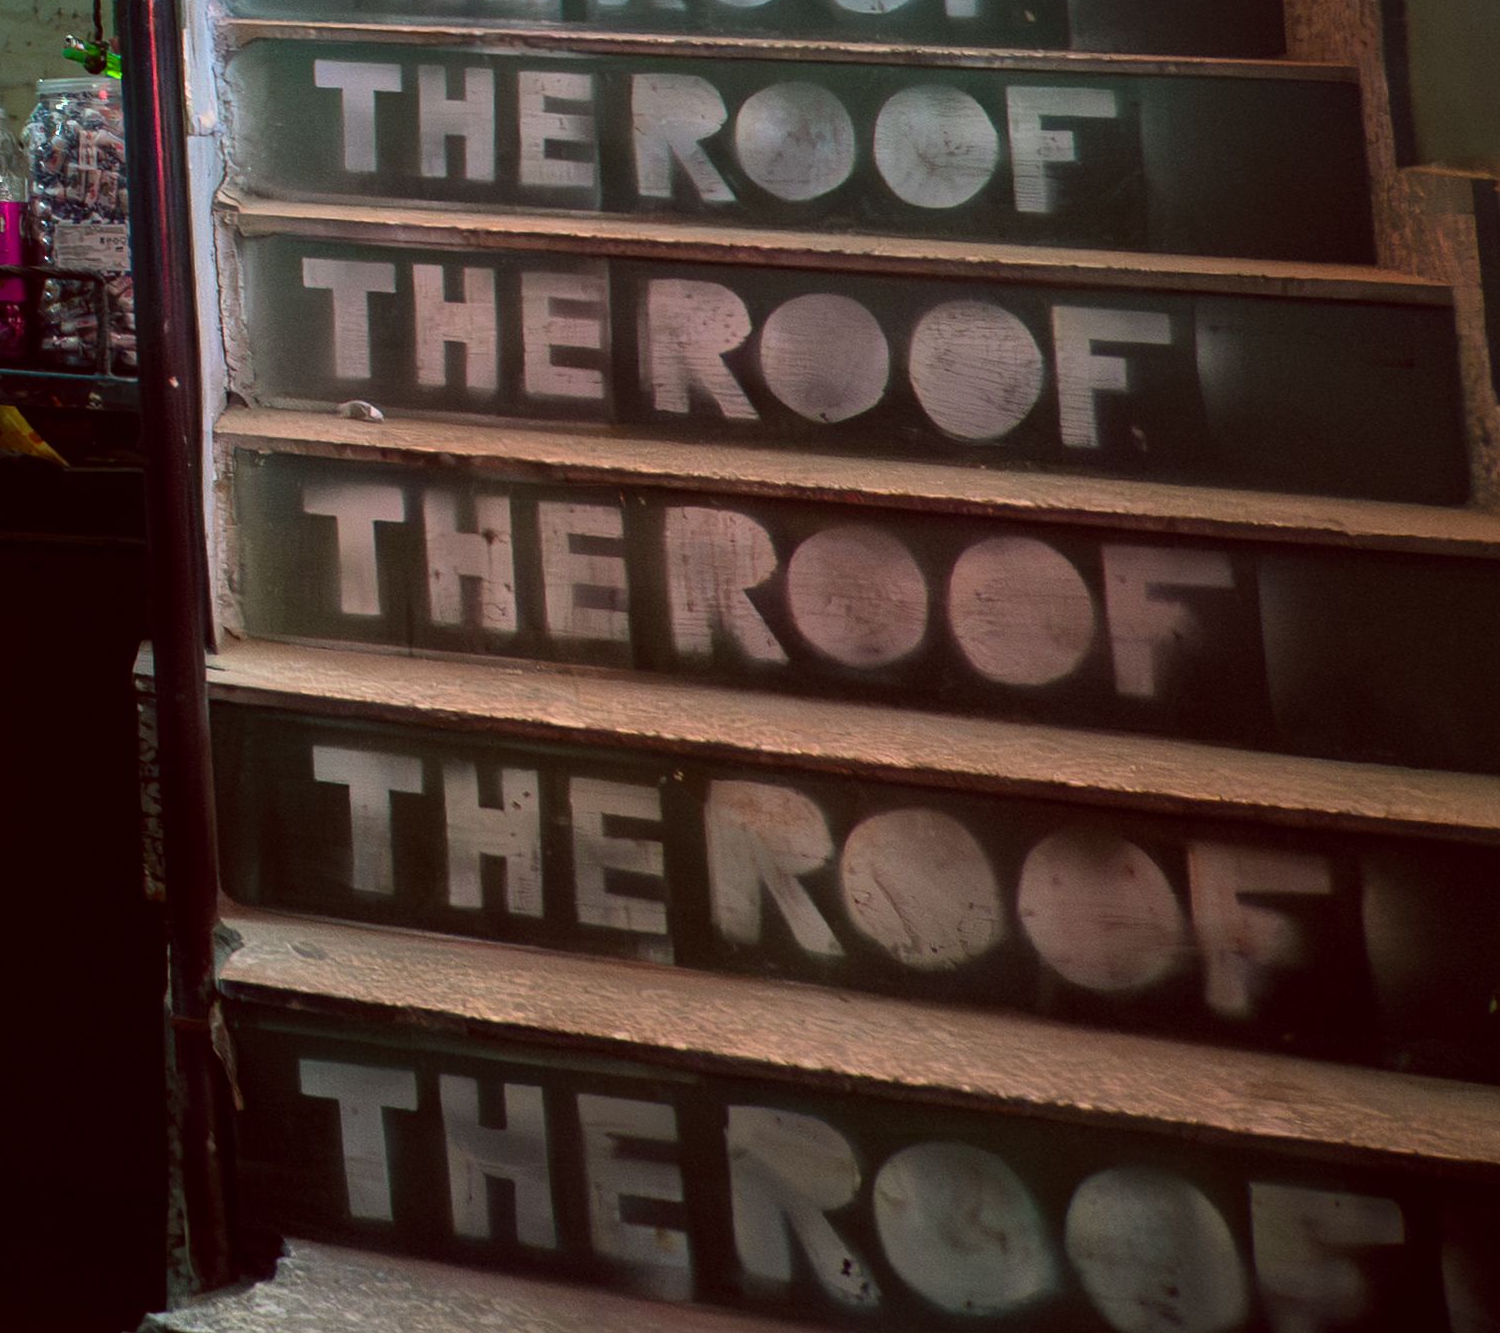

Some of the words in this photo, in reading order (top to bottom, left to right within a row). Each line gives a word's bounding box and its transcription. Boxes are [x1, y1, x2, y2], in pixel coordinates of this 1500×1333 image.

[313, 59, 598, 190] THE
[629, 71, 1118, 215] ROOF
[302, 258, 608, 401] THE
[646, 277, 1172, 450] ROOF
[303, 481, 632, 643] THE
[663, 503, 1236, 699] ROOF
[311, 744, 672, 948] THE
[705, 776, 1333, 1021] ROOF
[300, 1055, 695, 1305] THE
[726, 1103, 1407, 1333] ROOF
